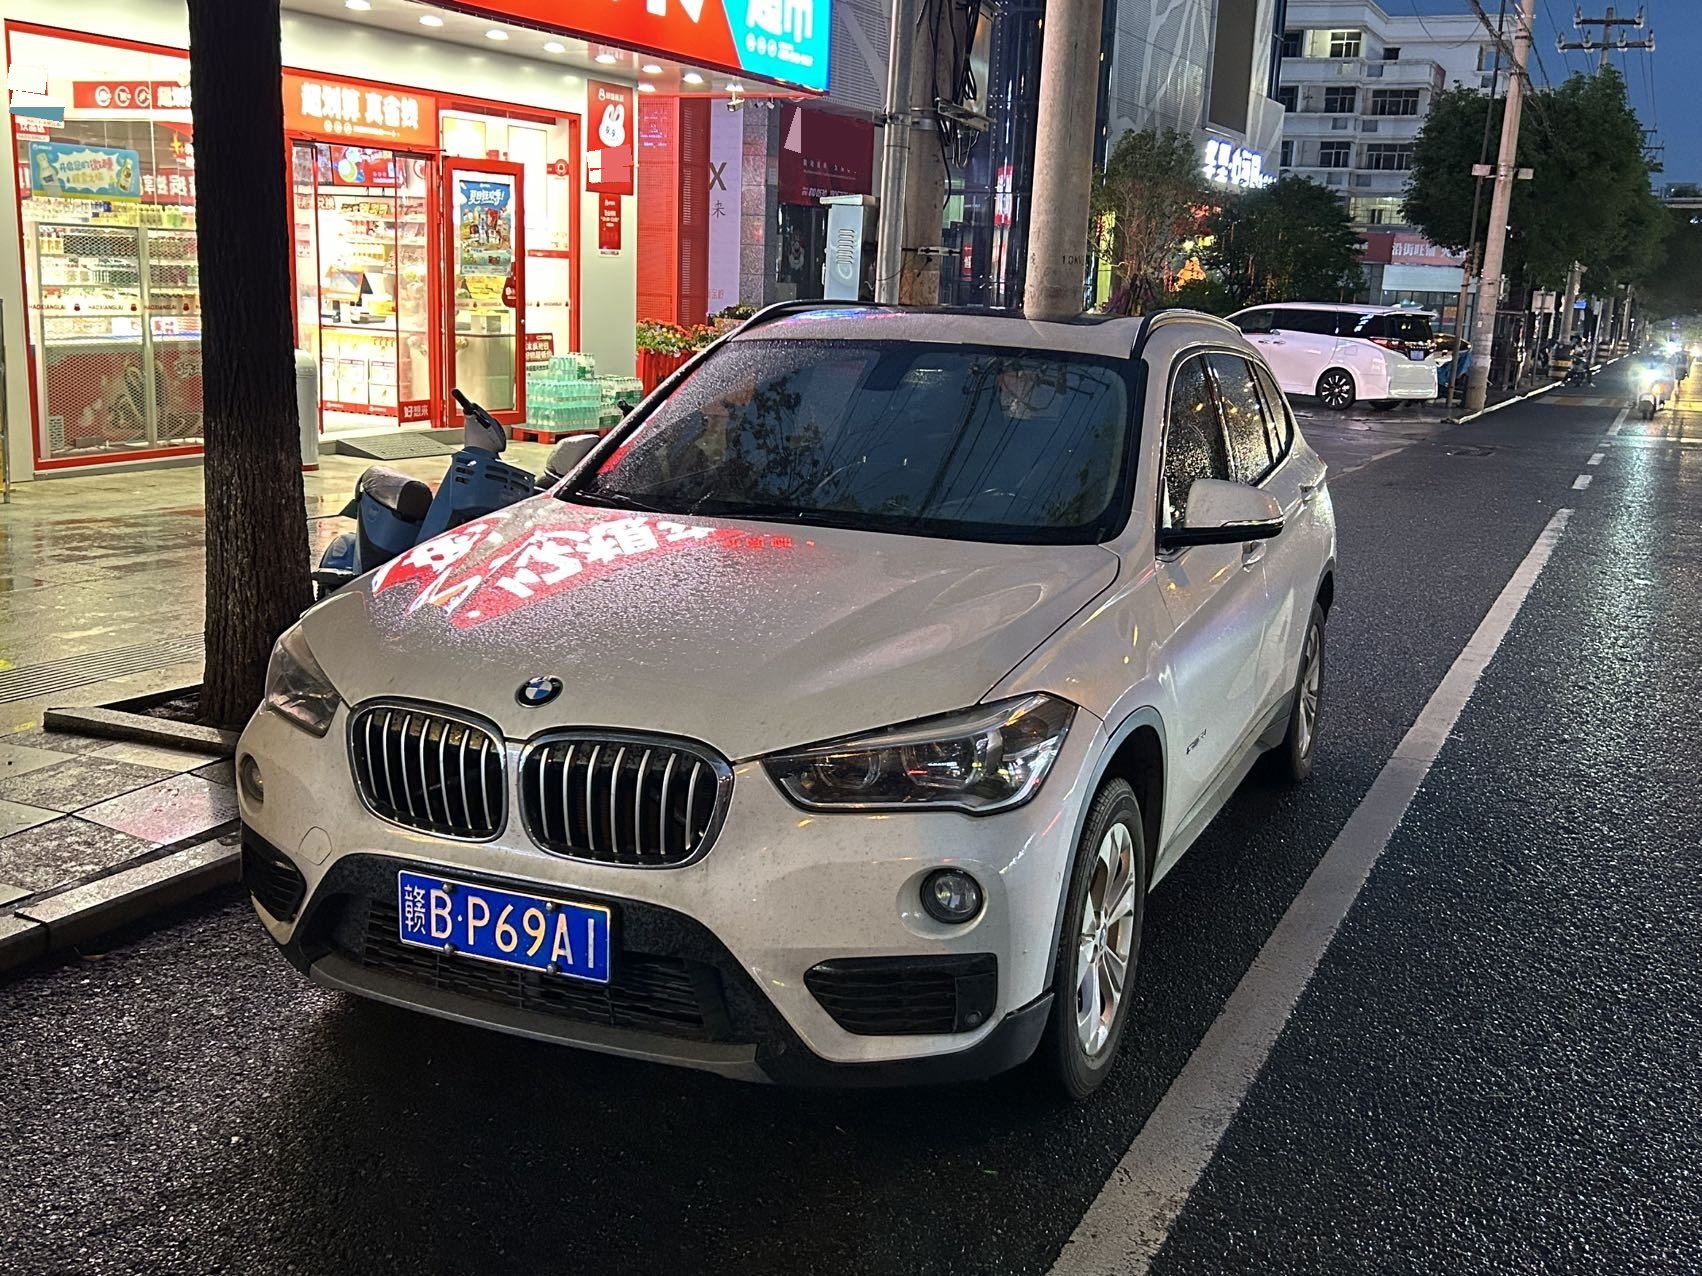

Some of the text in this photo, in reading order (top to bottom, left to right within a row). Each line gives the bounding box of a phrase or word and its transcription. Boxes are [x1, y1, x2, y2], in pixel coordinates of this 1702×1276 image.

[301, 82, 360, 122] 超划算
[403, 405, 429, 419] 好想来
